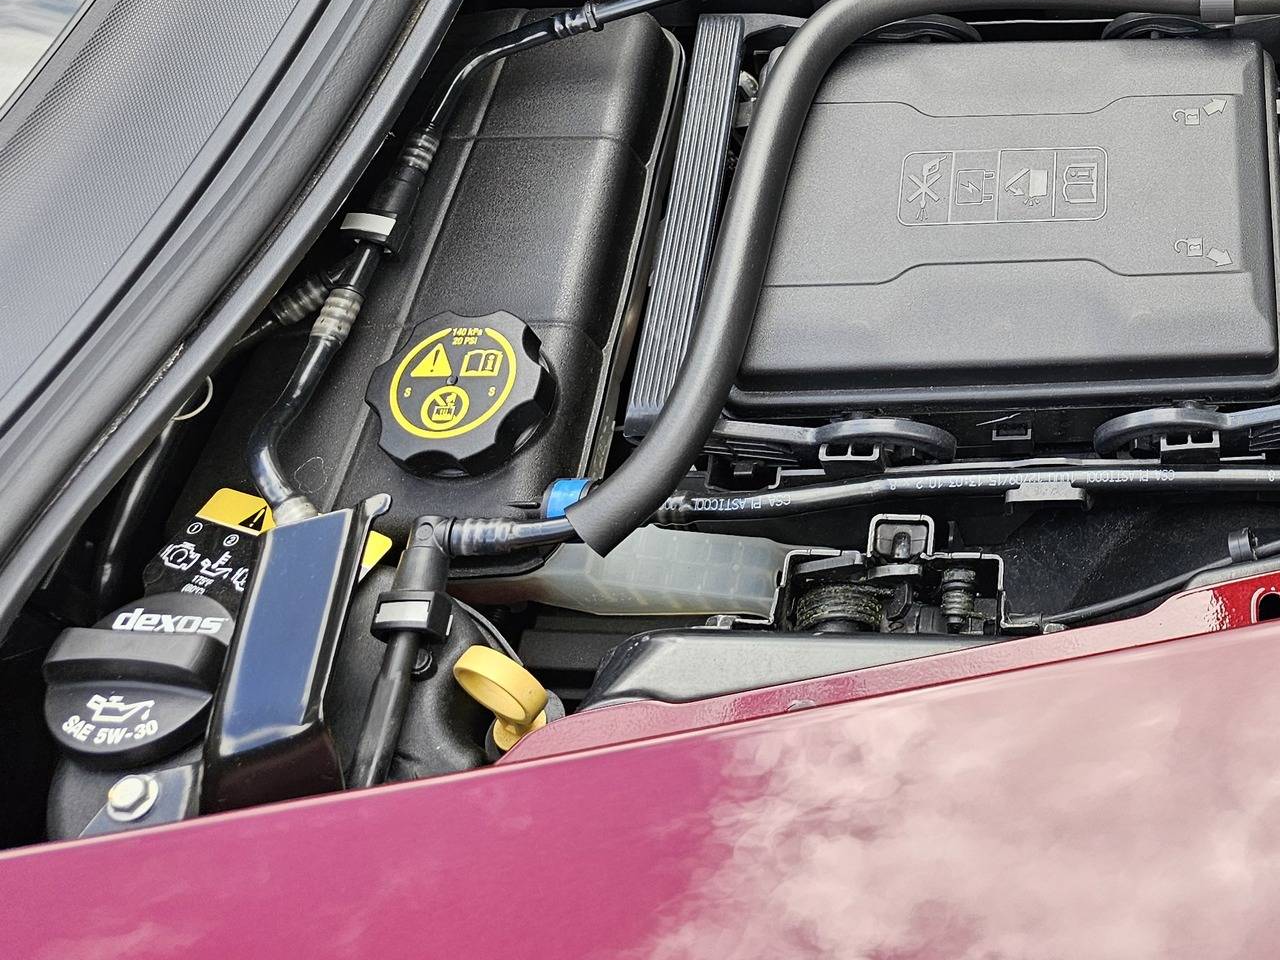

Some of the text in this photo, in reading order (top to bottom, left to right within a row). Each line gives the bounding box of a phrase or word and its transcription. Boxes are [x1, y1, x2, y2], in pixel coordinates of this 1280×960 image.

[452, 327, 467, 337] 140
[452, 336, 478, 346] 20 PSI
[691, 497, 762, 511] PLASTICOOL
[112, 607, 223, 634] dexos
[62, 714, 96, 742] SAE
[94, 719, 160, 745] 5W-30
